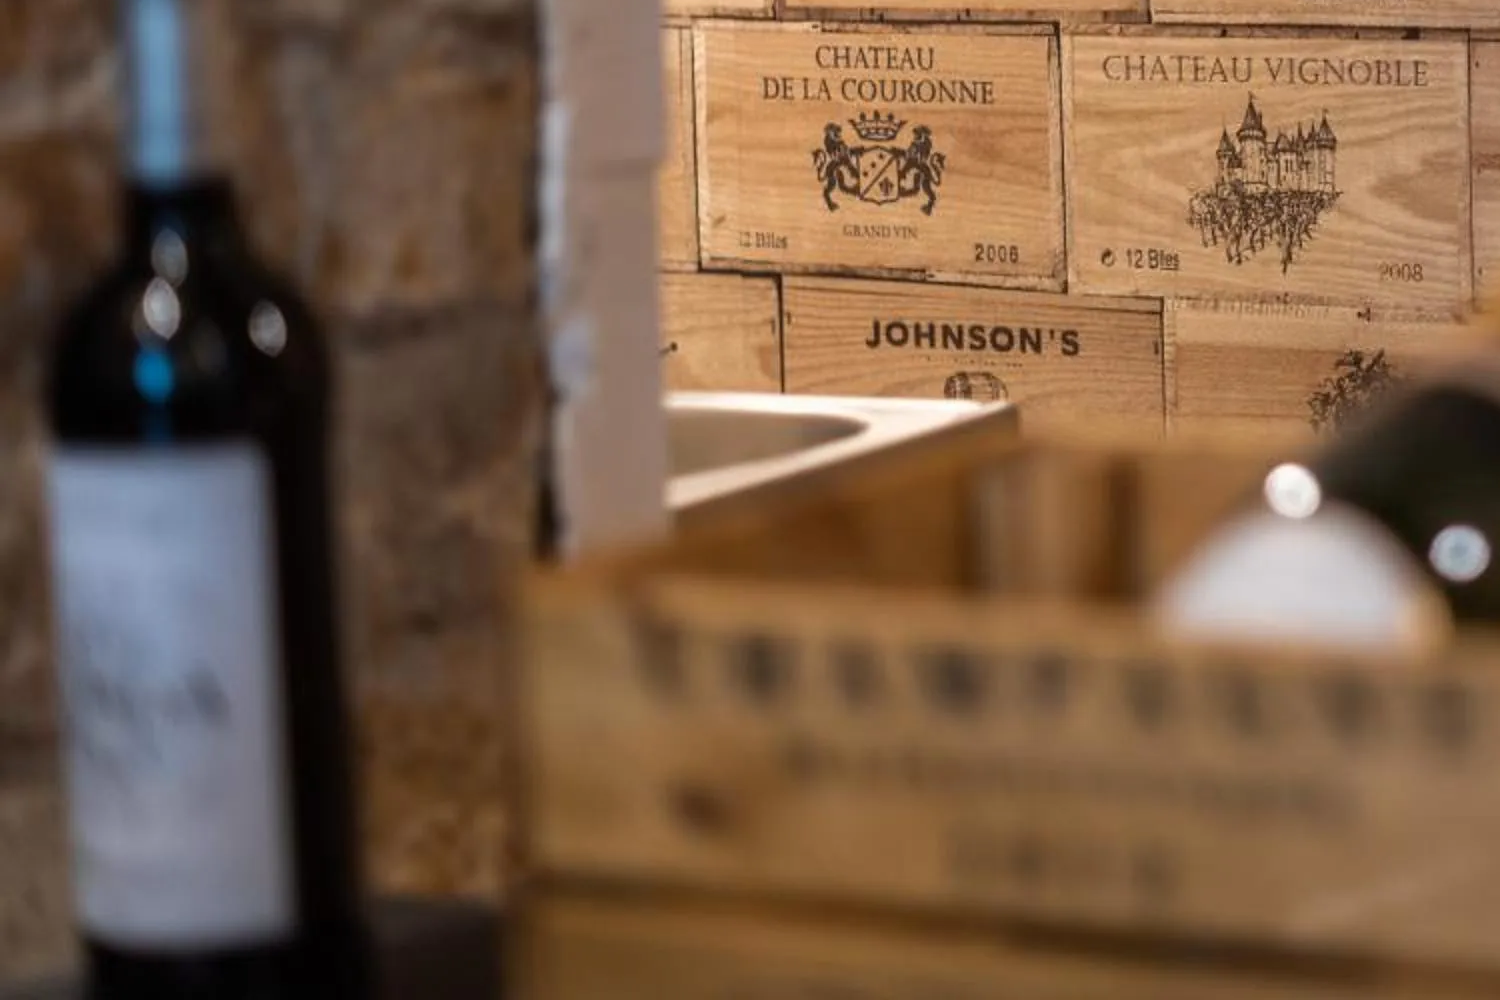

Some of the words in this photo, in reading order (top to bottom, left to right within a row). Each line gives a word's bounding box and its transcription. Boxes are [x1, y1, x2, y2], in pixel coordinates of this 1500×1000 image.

[815, 45, 934, 72] CHATEAU
[1102, 55, 1252, 85] CHATEAU
[1263, 57, 1429, 87] VIGNOBLE
[762, 77, 795, 101] DE
[801, 77, 833, 101] LA
[841, 77, 995, 105] COURONNE
[842, 223, 890, 239] GRAND
[893, 224, 919, 241] VIN
[1125, 248, 1144, 269] 12
[1378, 262, 1424, 282] 2008
[865, 319, 1081, 357] JOHNSON'S
